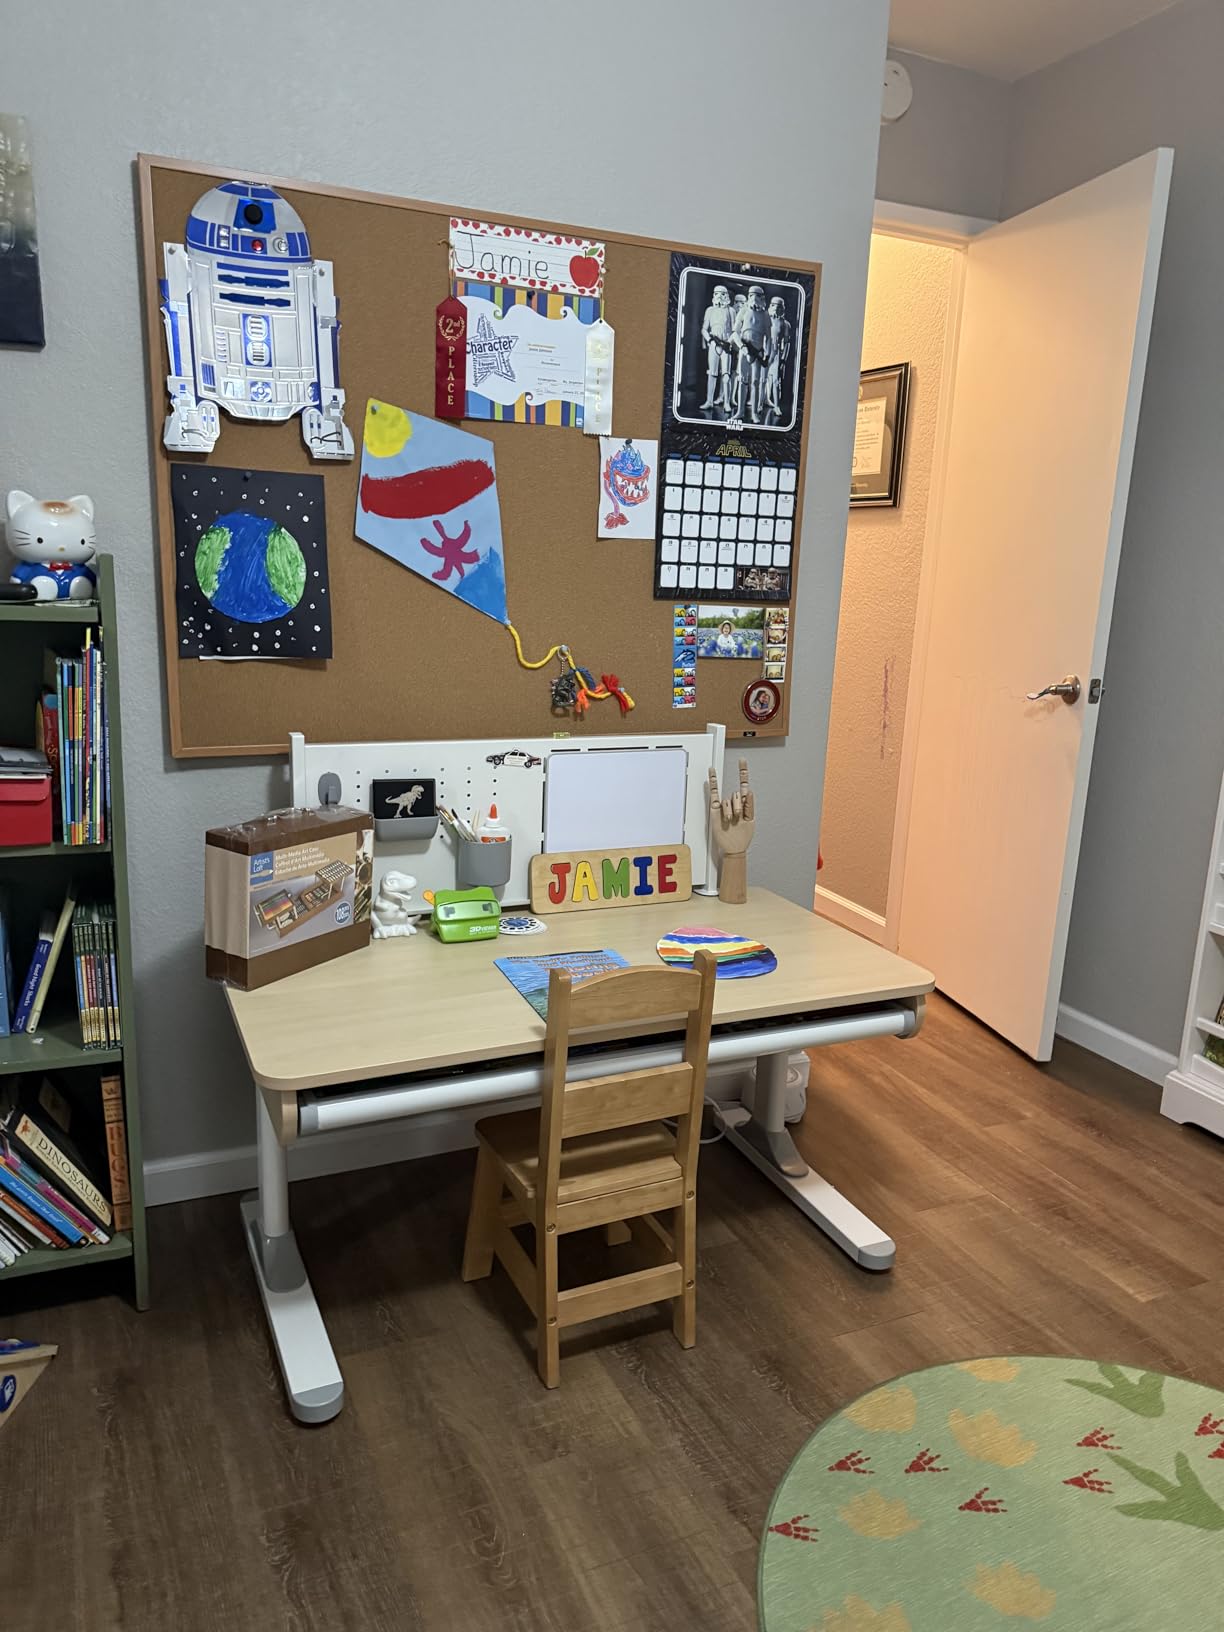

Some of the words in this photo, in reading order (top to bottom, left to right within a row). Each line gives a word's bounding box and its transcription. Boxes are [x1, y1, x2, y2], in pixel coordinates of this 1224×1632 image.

[454, 230, 550, 280] Jamie
[446, 318, 460, 333] 2nd
[447, 346, 455, 405] PLACE
[716, 444, 752, 458] APRIL
[548, 854, 678, 904] JAMIE
[37, 1137, 107, 1213] DINOSAURS
